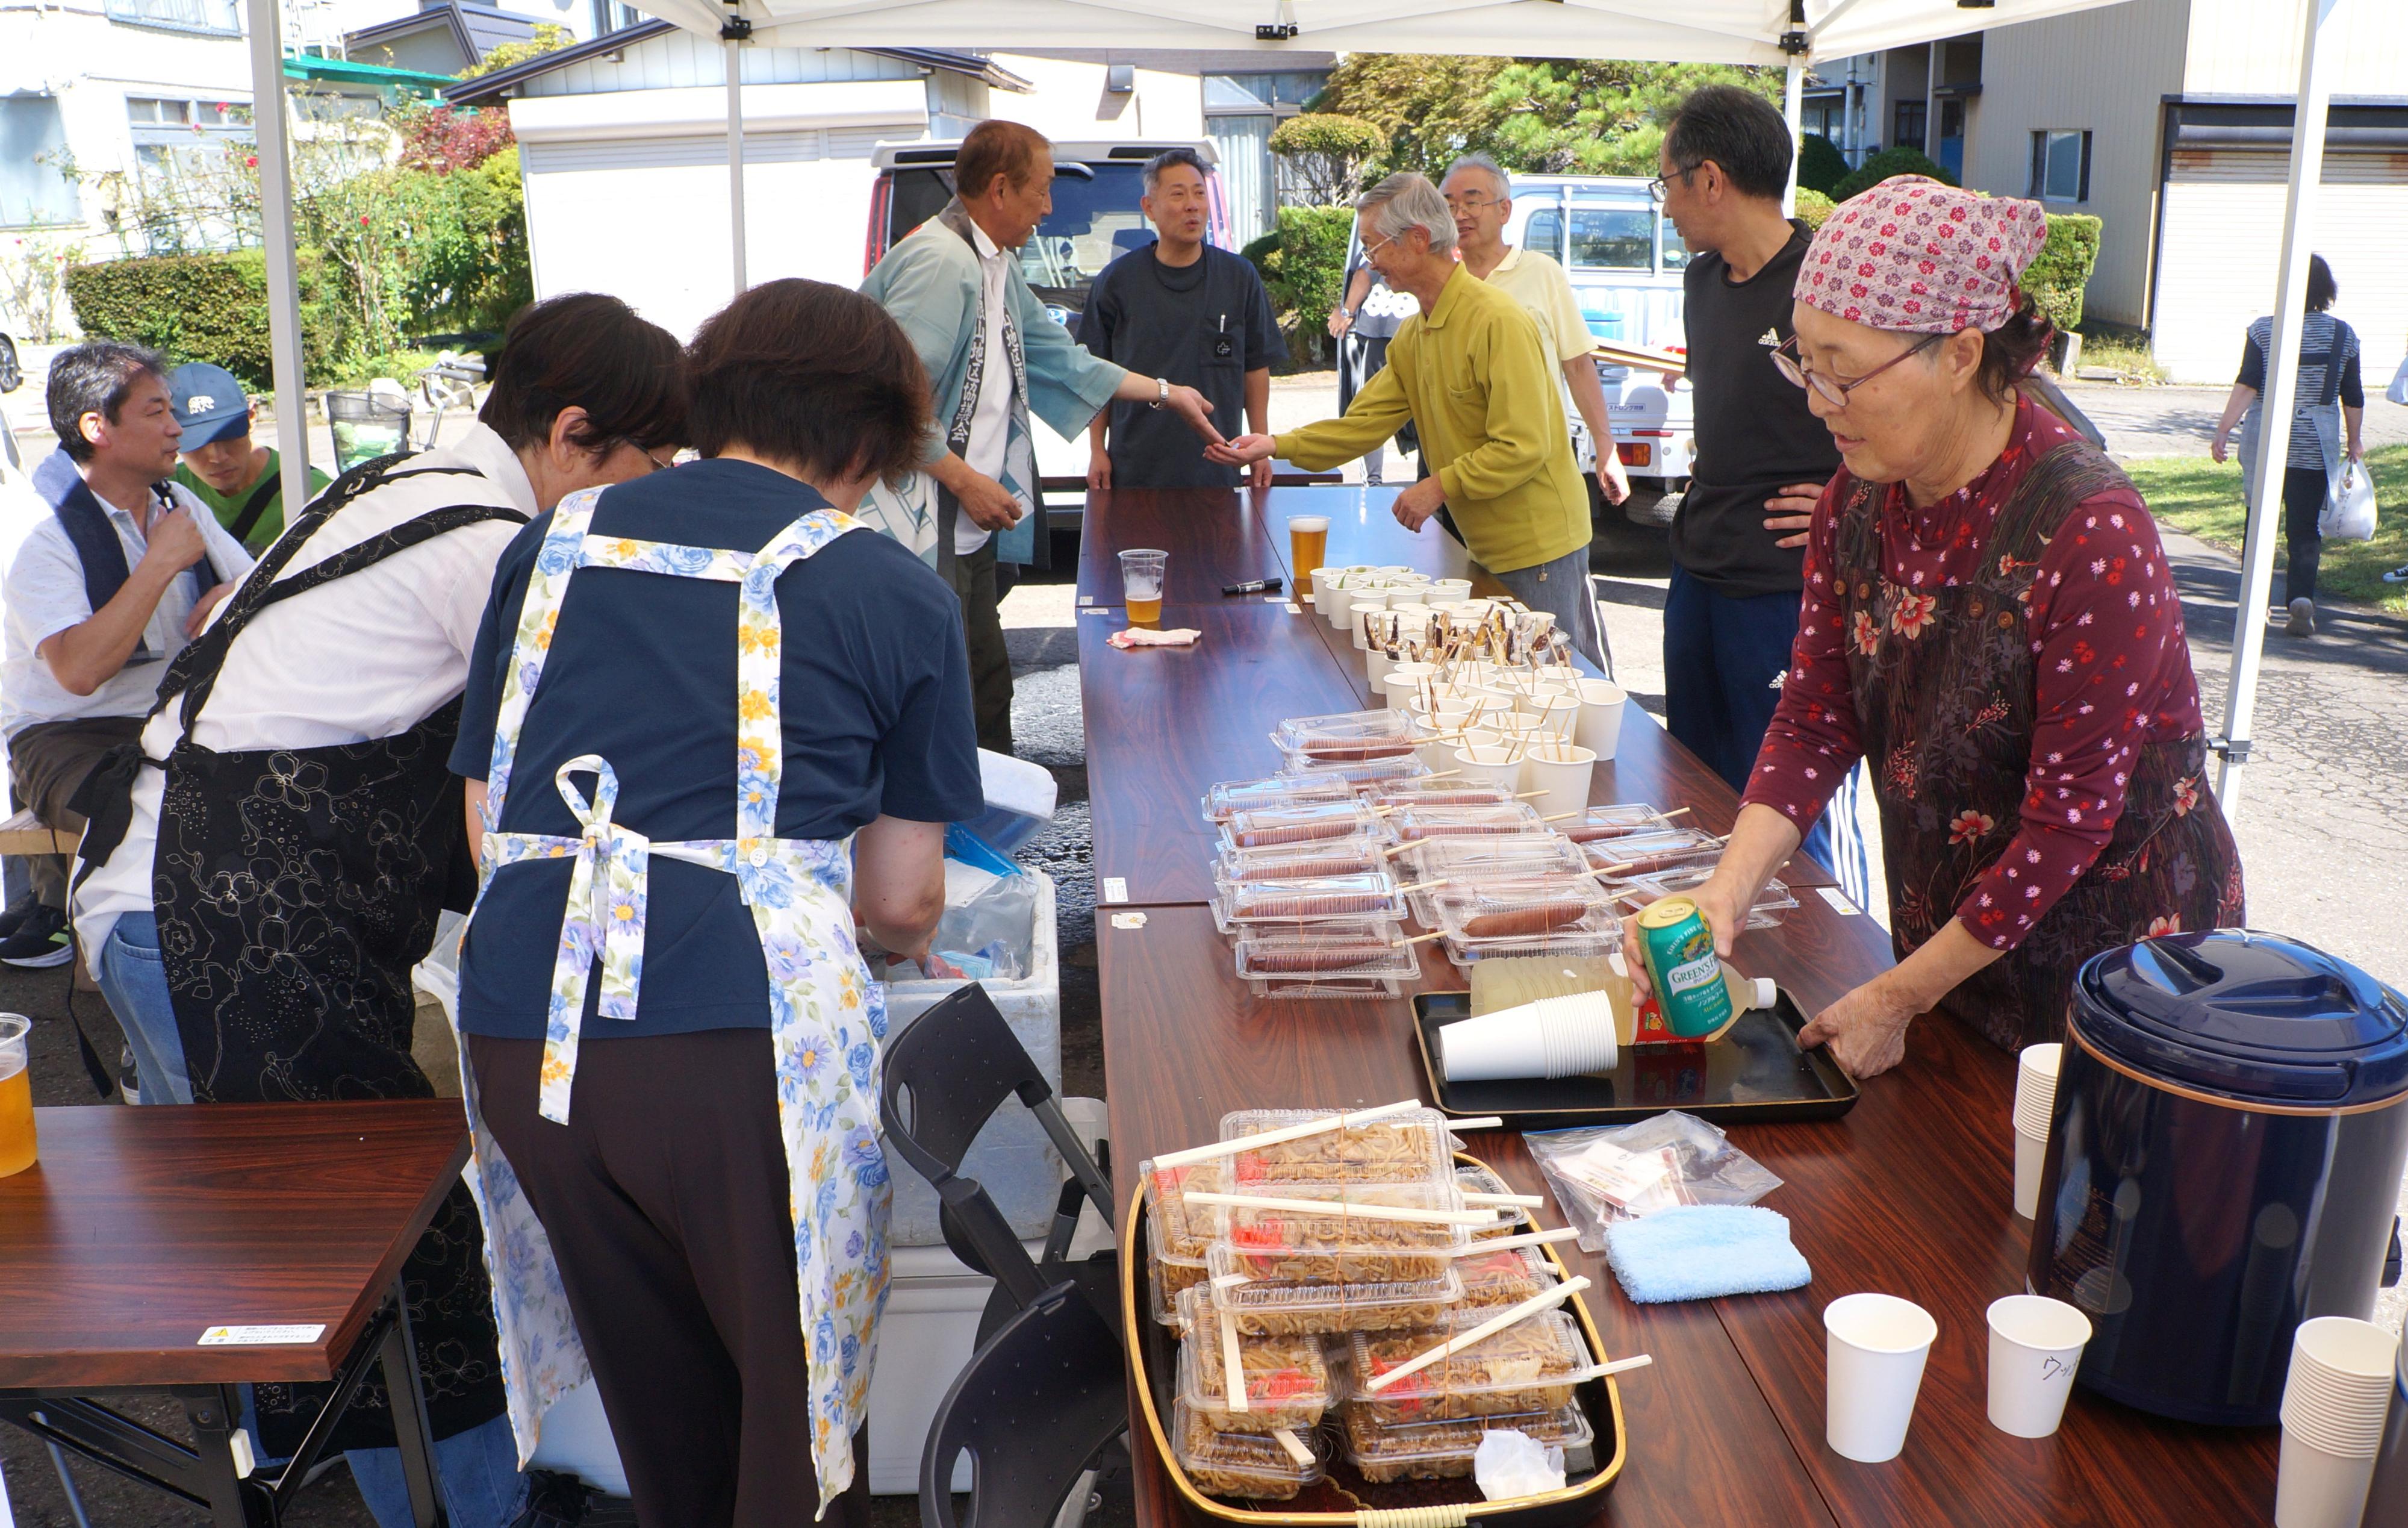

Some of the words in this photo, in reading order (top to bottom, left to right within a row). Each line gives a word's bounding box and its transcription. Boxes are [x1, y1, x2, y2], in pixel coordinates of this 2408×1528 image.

[1758, 338, 1781, 347] adidas
[951, 287, 986, 443] 山地区協議会
[1672, 961, 1710, 983] GREEN'S
